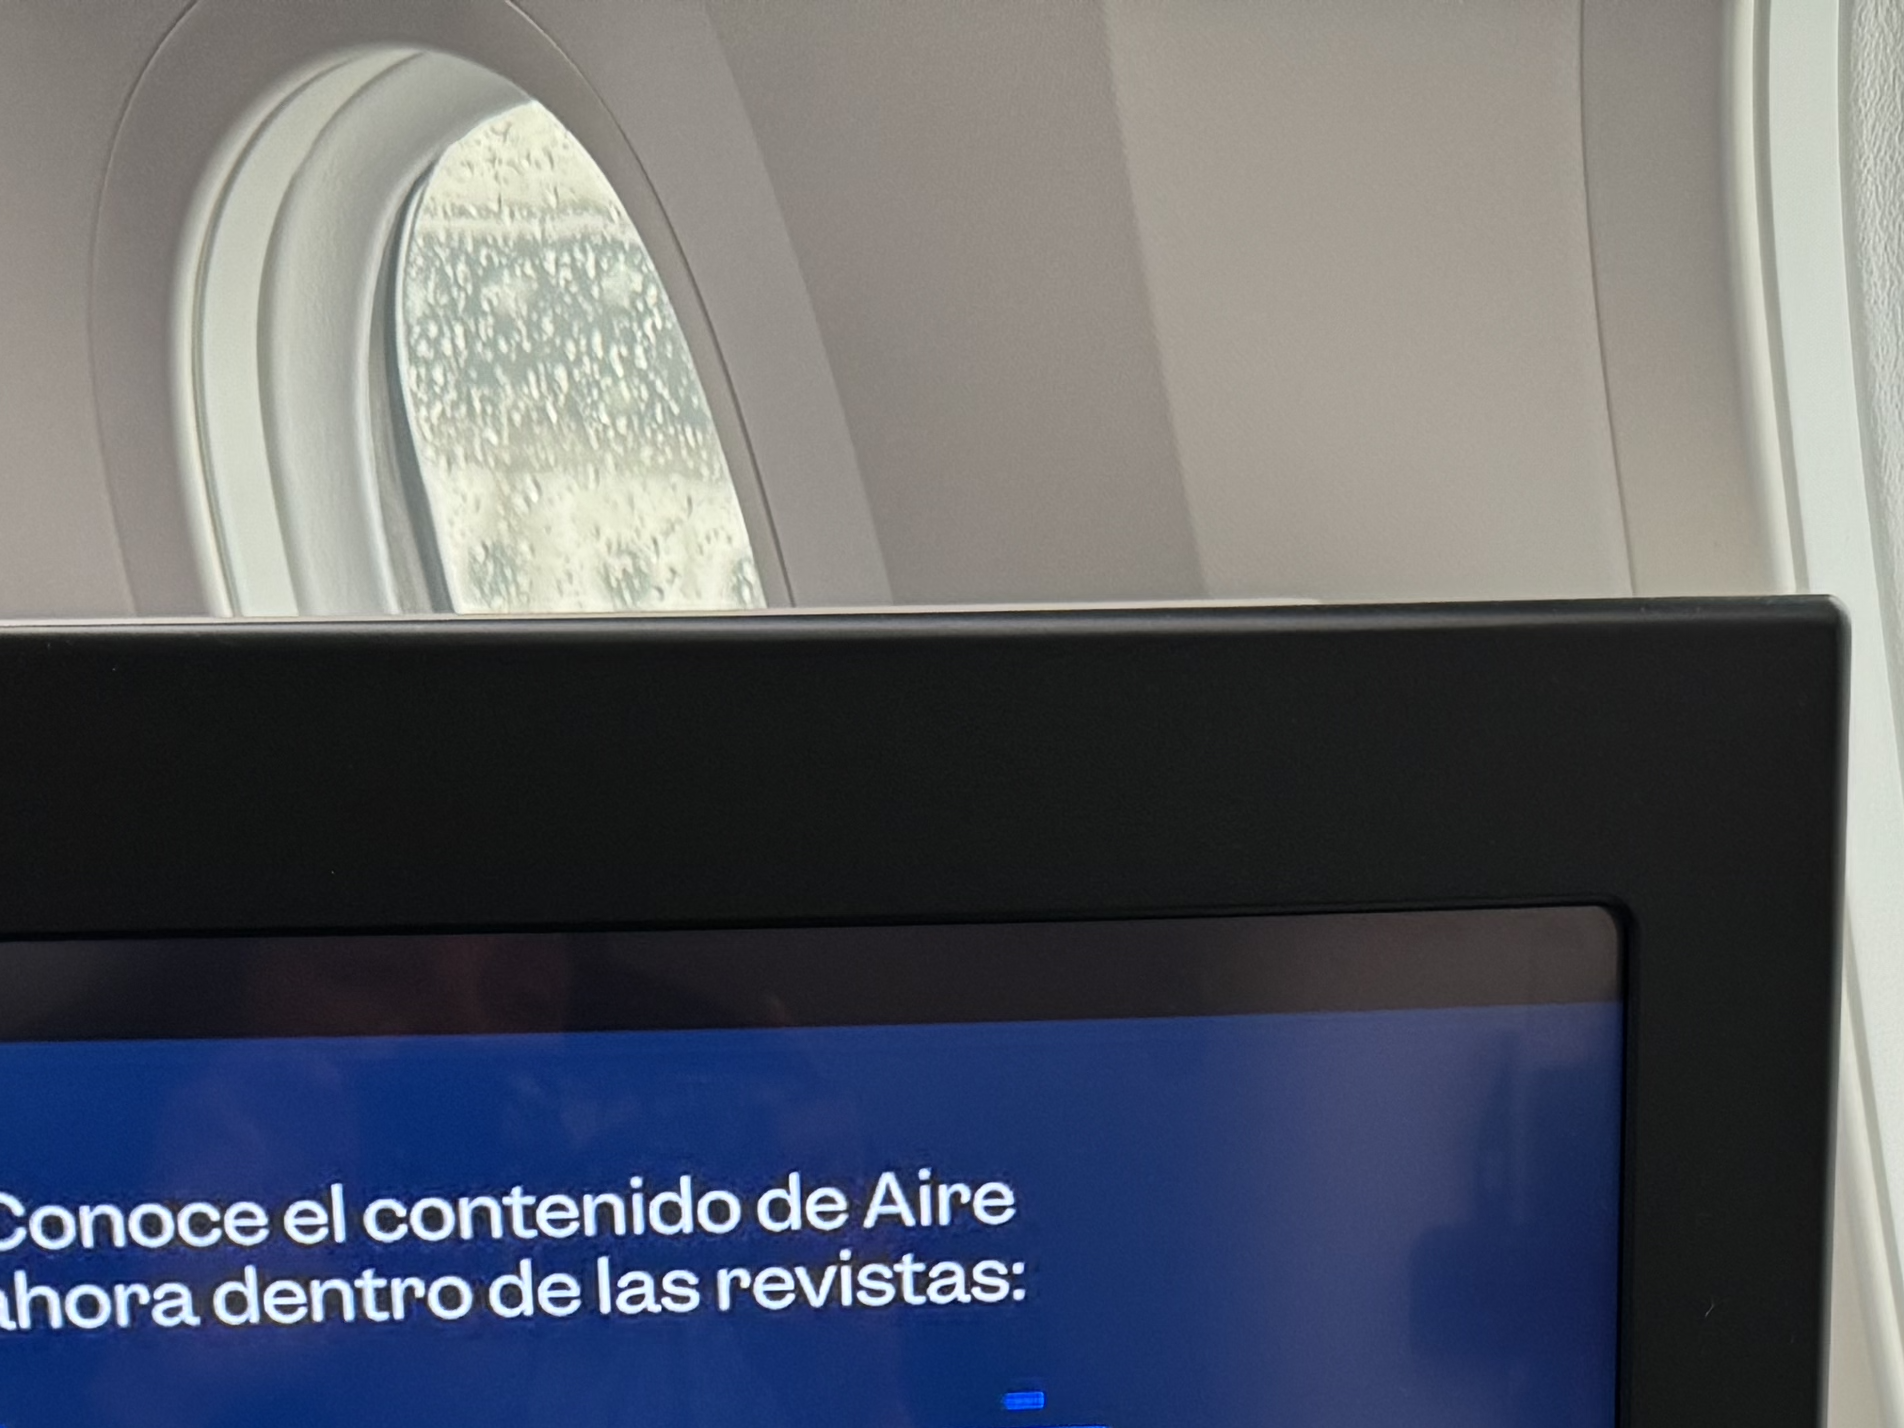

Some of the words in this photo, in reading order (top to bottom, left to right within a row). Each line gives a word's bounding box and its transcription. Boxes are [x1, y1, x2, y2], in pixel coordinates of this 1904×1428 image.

[283, 1182, 346, 1245] el
[362, 1175, 742, 1243] contenido
[756, 1171, 850, 1231] de
[862, 1167, 1016, 1229] Aire
[212, 1264, 473, 1324] dentro
[488, 1258, 581, 1318] de
[596, 1255, 700, 1315] las
[716, 1248, 1026, 1312] revistas:
